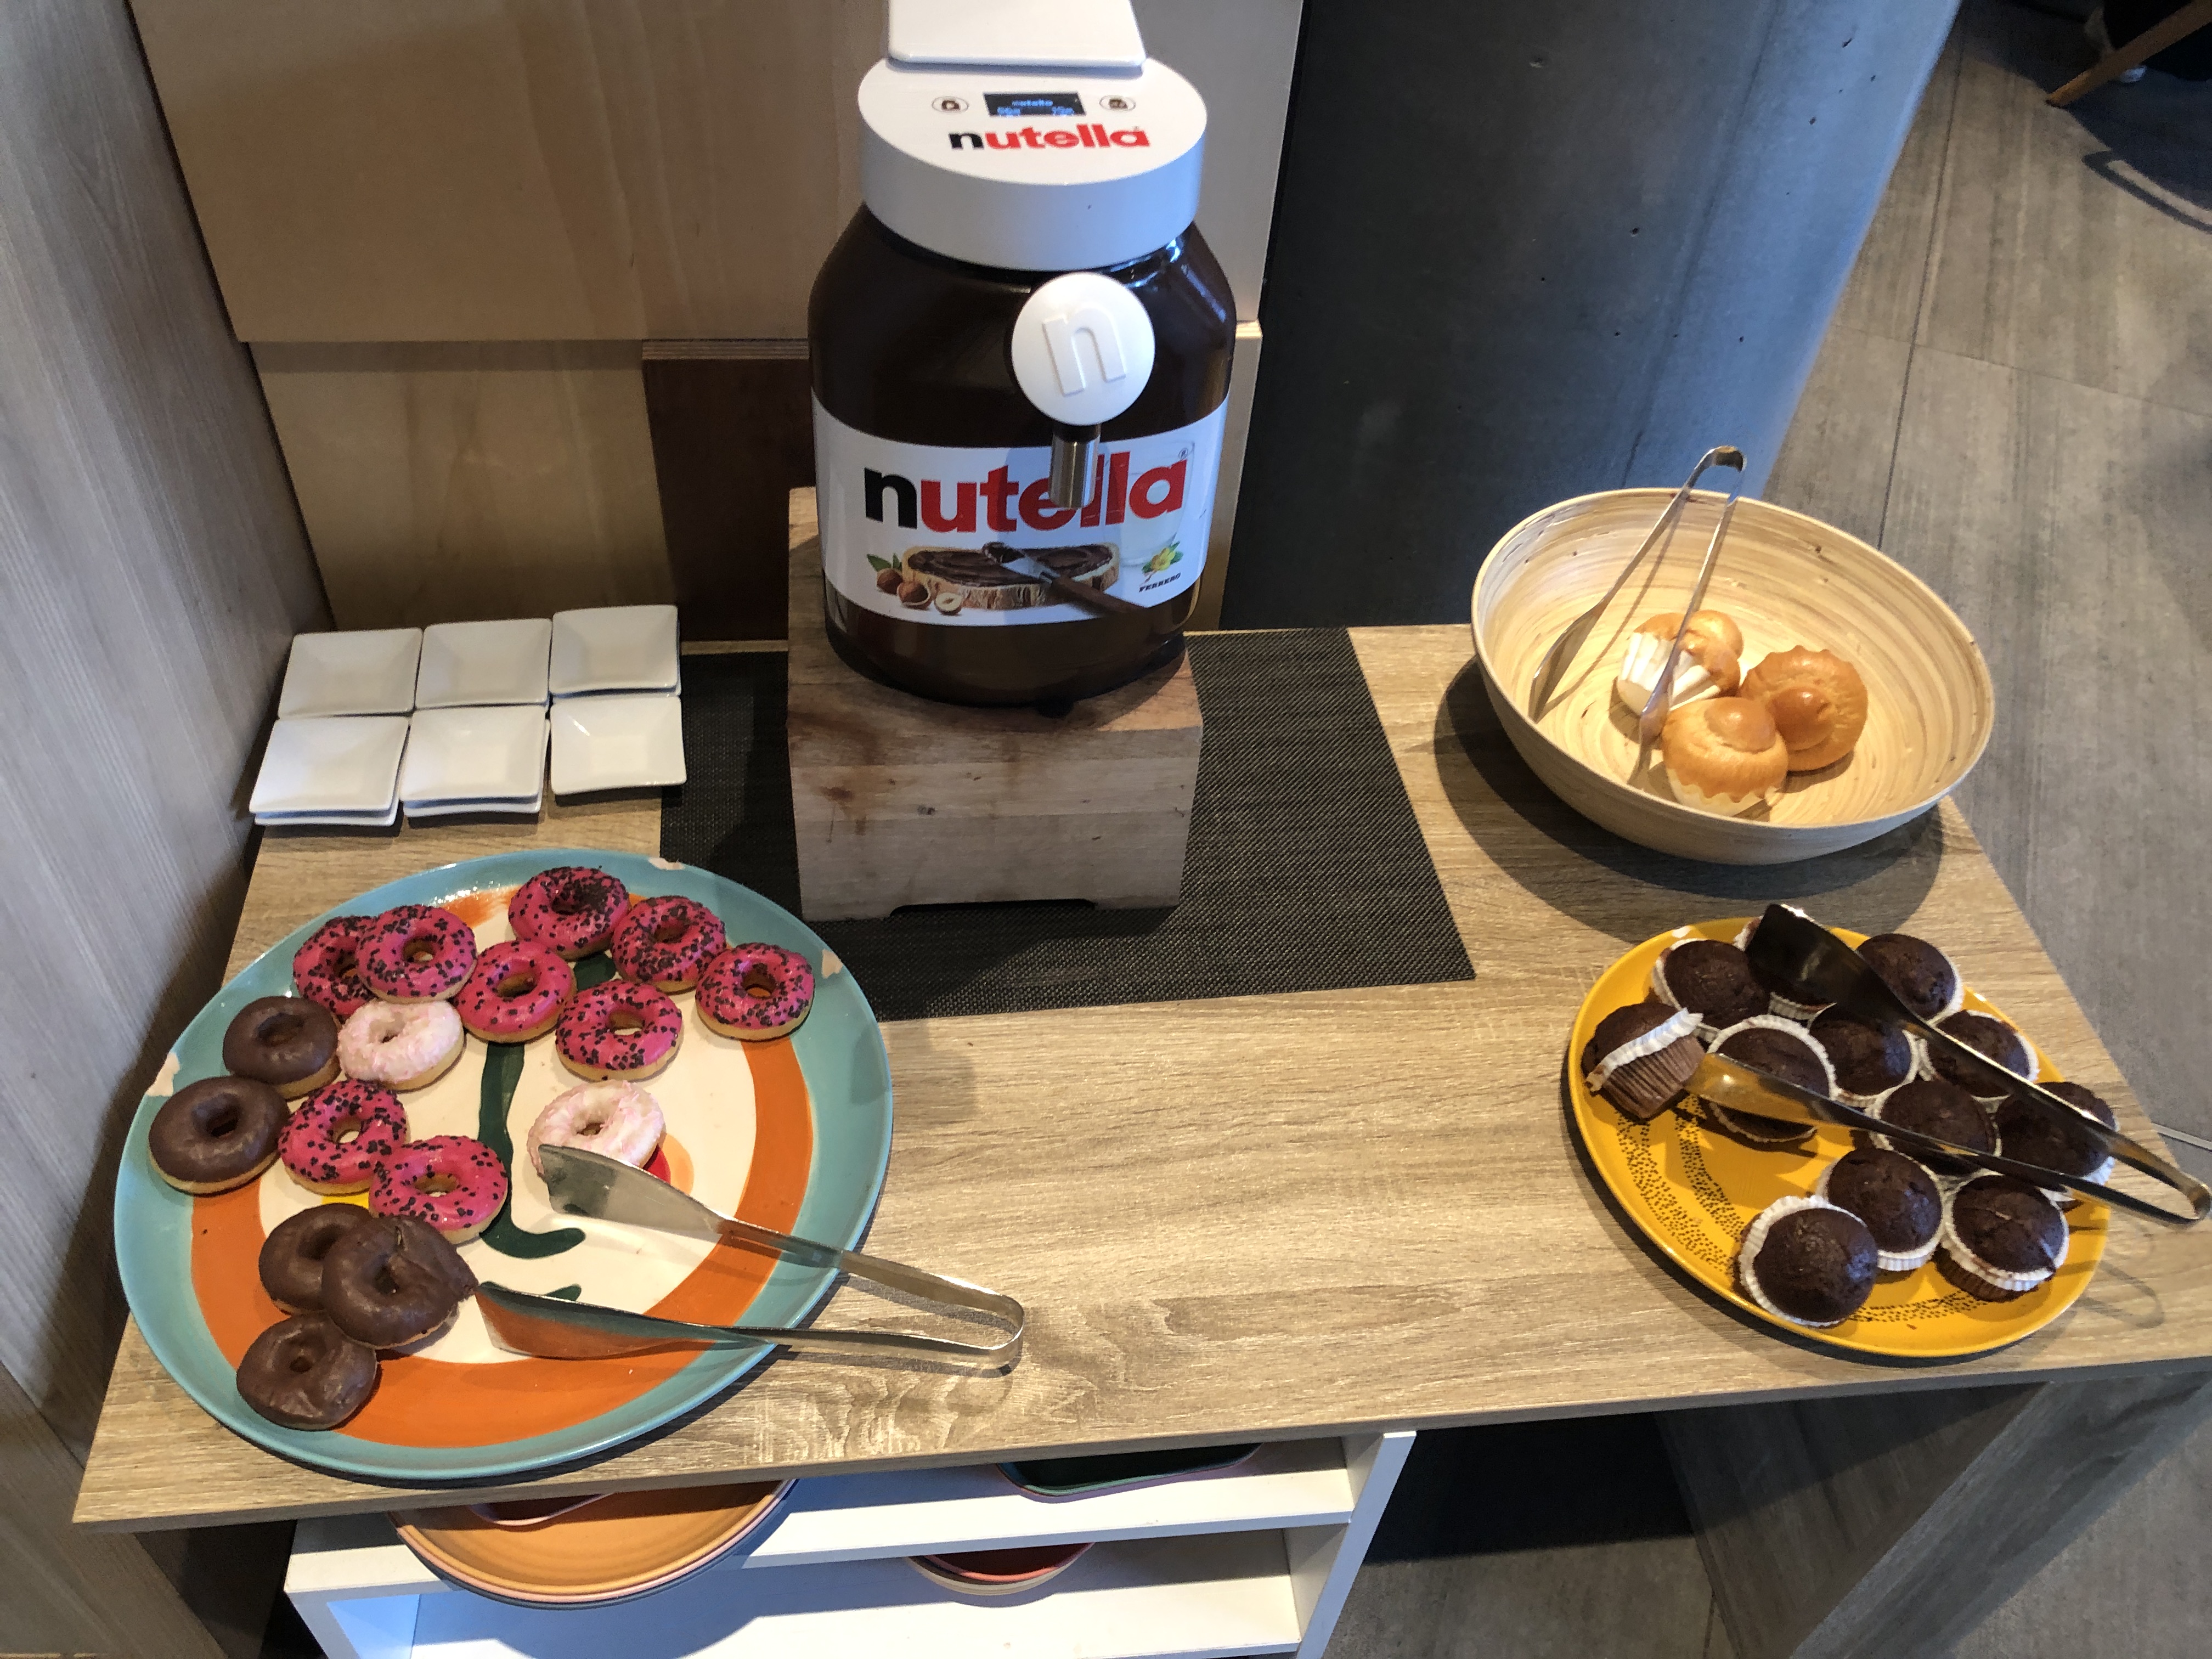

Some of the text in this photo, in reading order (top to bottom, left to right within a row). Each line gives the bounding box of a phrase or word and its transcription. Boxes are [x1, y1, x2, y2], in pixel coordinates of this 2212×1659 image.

[949, 123, 1150, 149] nutella
[1042, 301, 1126, 397] n
[864, 451, 1187, 533] nutella
